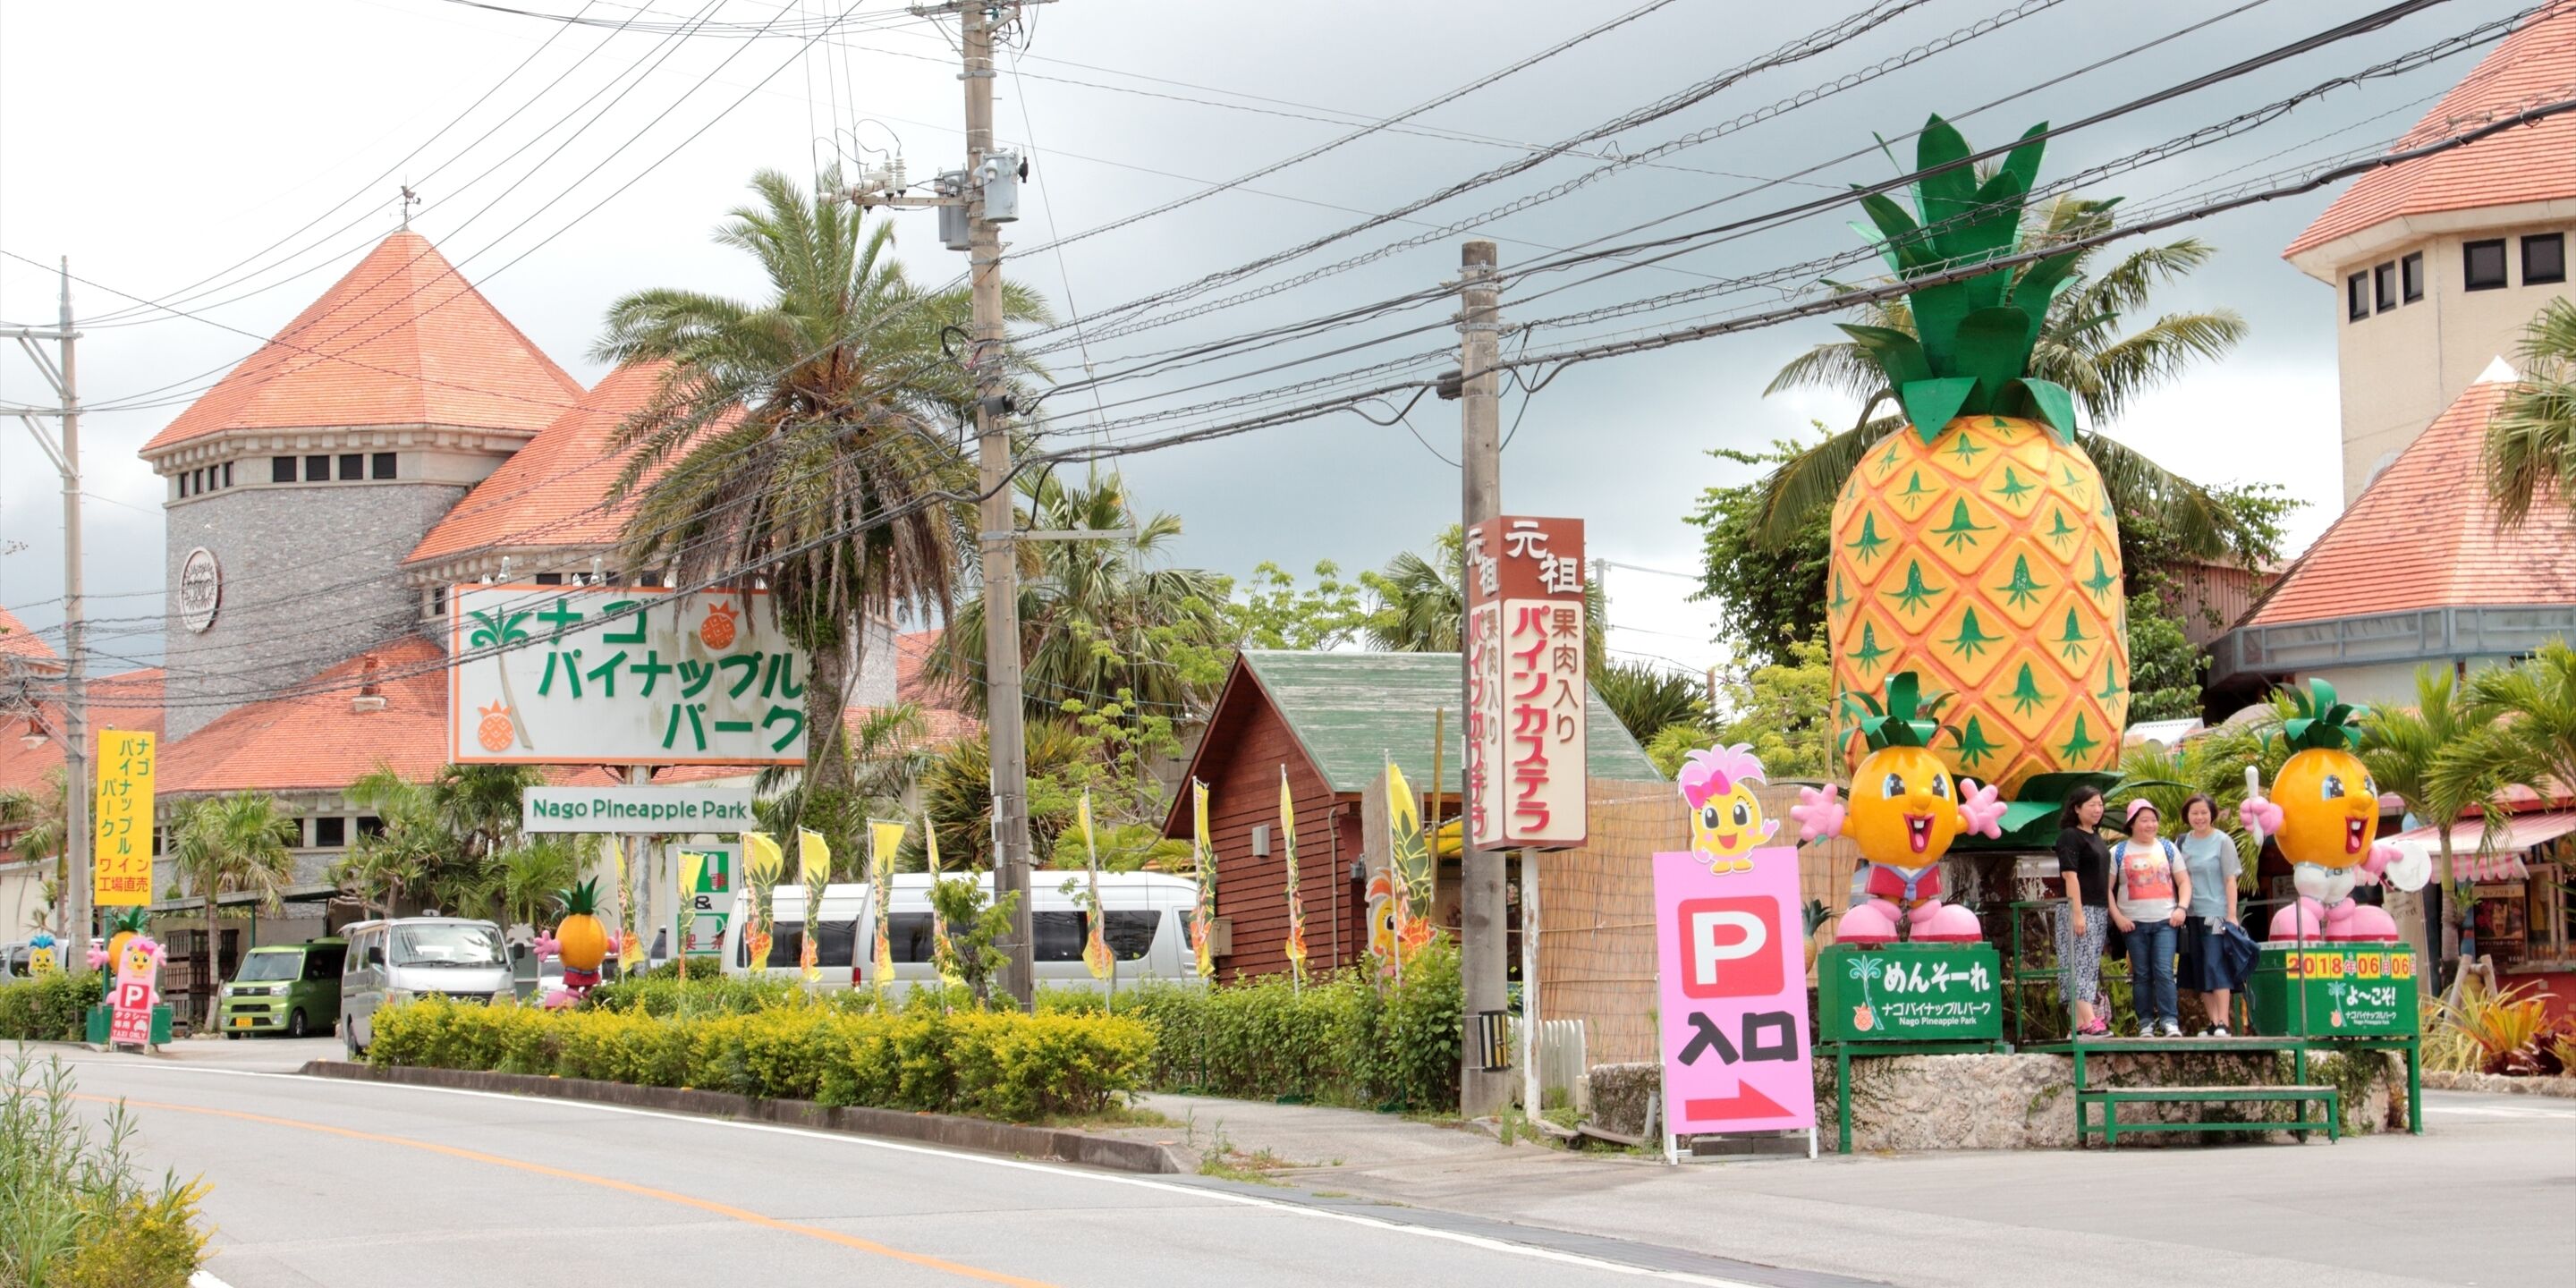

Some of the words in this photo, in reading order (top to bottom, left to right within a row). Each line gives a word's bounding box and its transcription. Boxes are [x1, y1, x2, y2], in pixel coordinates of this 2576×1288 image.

[1467, 527, 1500, 597] 元祖
[1504, 521, 1583, 595] 元祖
[538, 648, 803, 699] パイナップル
[1552, 608, 1579, 743] 果肉入り
[662, 703, 803, 753] パーク
[1468, 608, 1488, 839] パインカステラ
[1512, 605, 1551, 833] パインカステラ
[137, 738, 150, 776] ナゴ
[101, 777, 117, 837] パーク
[117, 738, 134, 855] パイナップル
[533, 799, 588, 819] Nago
[592, 799, 698, 821] Pineapple
[702, 801, 747, 819] Park
[98, 876, 148, 893] 工場直売
[99, 858, 149, 873] ワイン
[1691, 910, 1767, 986] P
[125, 986, 143, 1007] P
[1884, 962, 1991, 995] めんそーれ
[115, 1012, 148, 1020] タクシー
[1881, 1002, 1992, 1017] ナゴパイナップルパーク
[1899, 1017, 1920, 1028] Nago
[1921, 1016, 1960, 1027] Pineapple
[1961, 1016, 1978, 1025] Park
[1677, 1010, 1800, 1067] 入口
